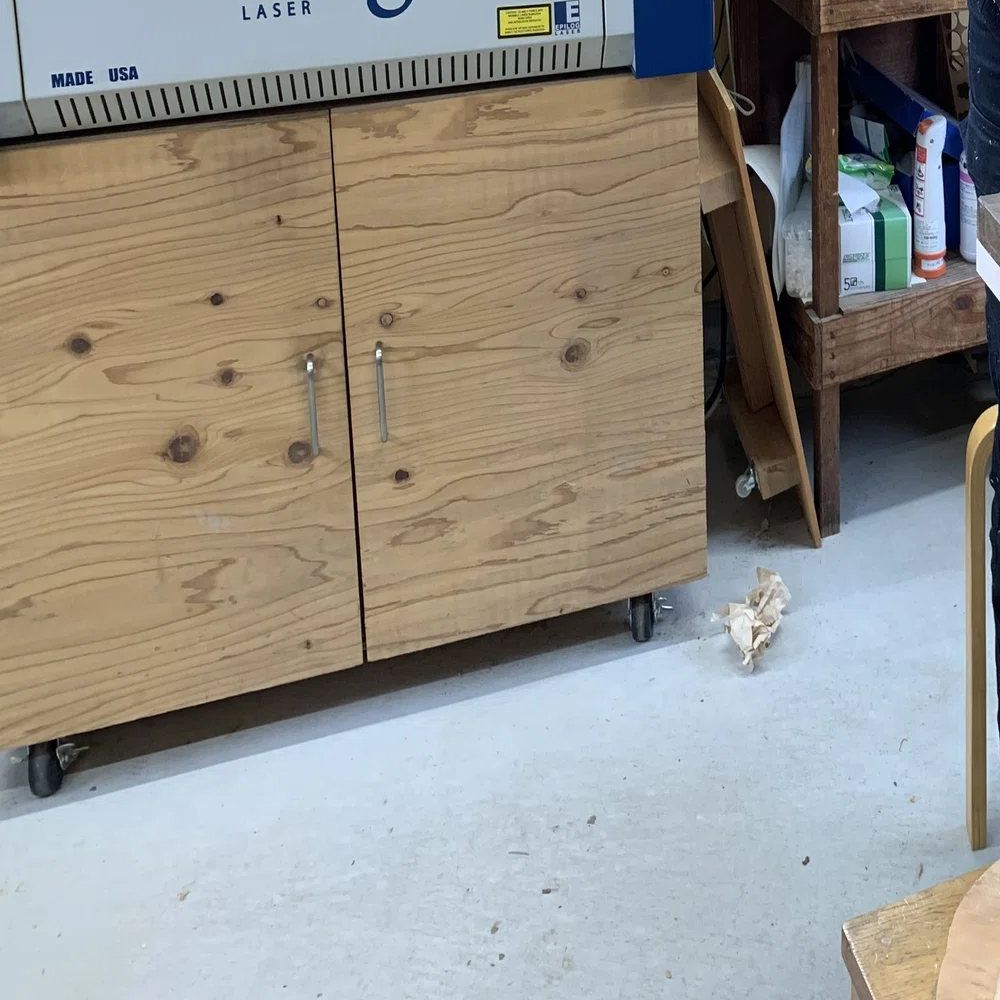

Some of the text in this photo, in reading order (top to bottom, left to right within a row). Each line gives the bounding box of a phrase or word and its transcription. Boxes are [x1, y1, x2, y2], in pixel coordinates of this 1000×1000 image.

[242, 0, 311, 21] LASER
[555, 22, 580, 30] EPILOG
[51, 66, 139, 88] MADE USA
